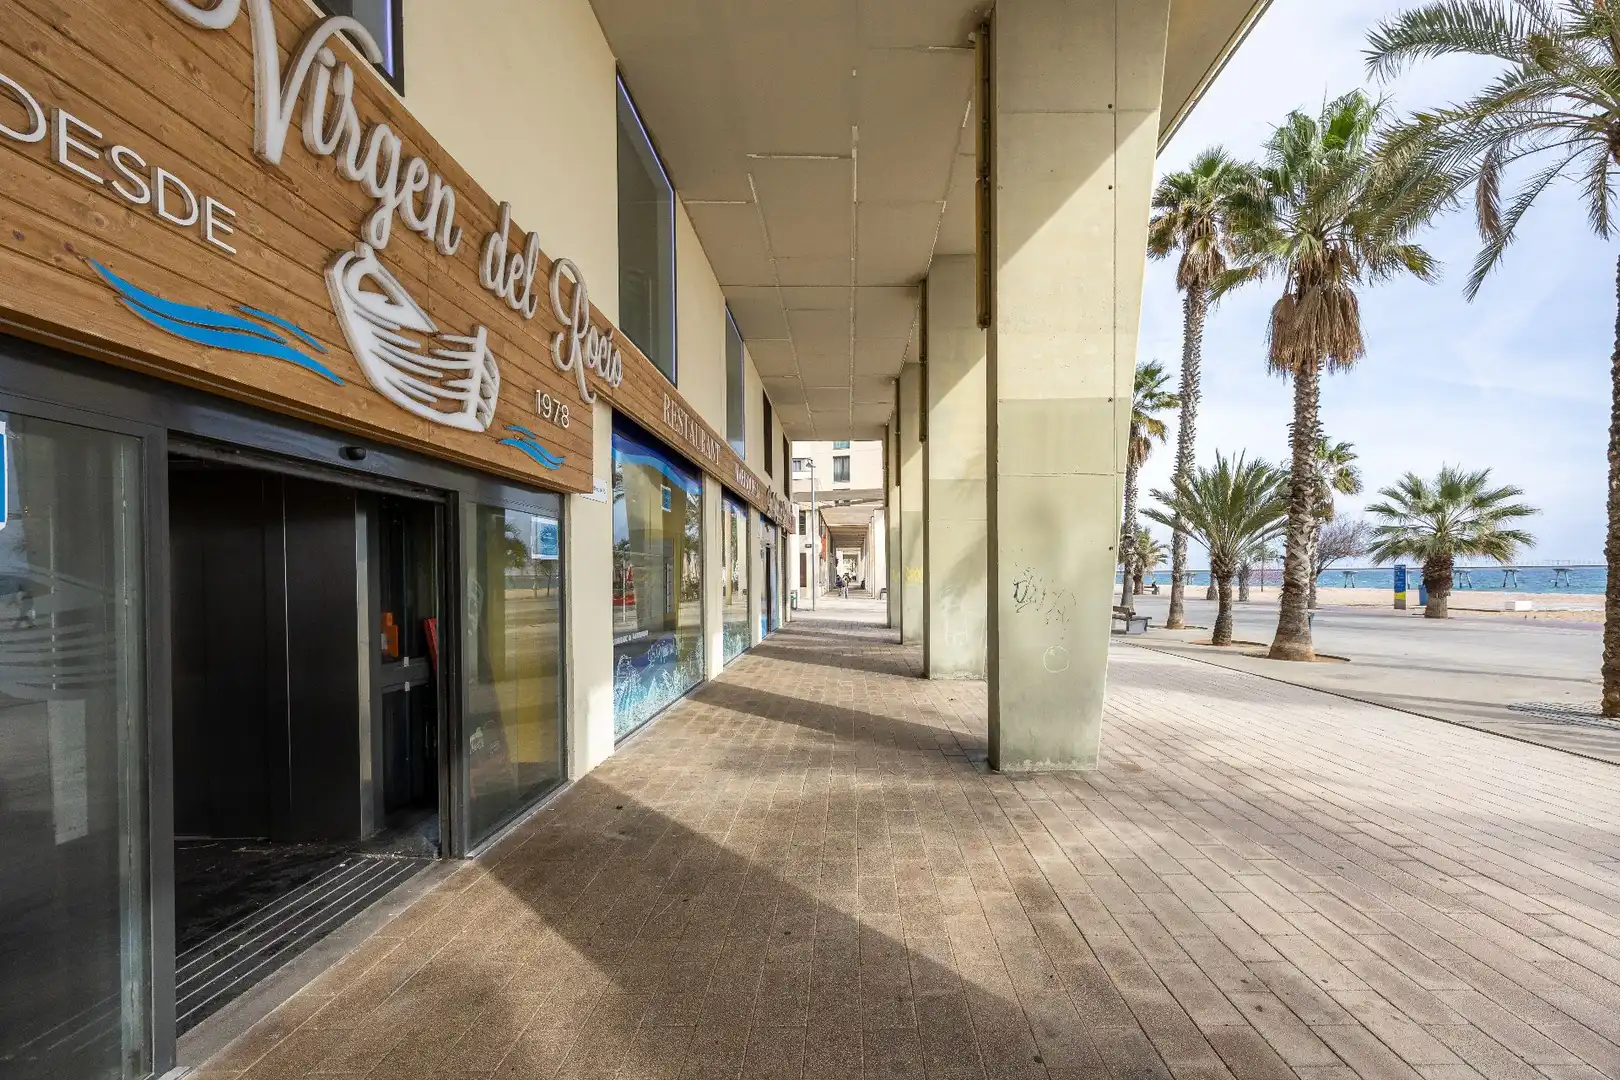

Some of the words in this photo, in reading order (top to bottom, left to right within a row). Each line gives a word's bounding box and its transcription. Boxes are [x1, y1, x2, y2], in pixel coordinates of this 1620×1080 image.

[0, 73, 237, 255] DESDE
[535, 389, 569, 428] 1978
[249, 0, 463, 257] Virgen
[479, 201, 540, 320] del
[663, 392, 720, 465] RESTAURANT
